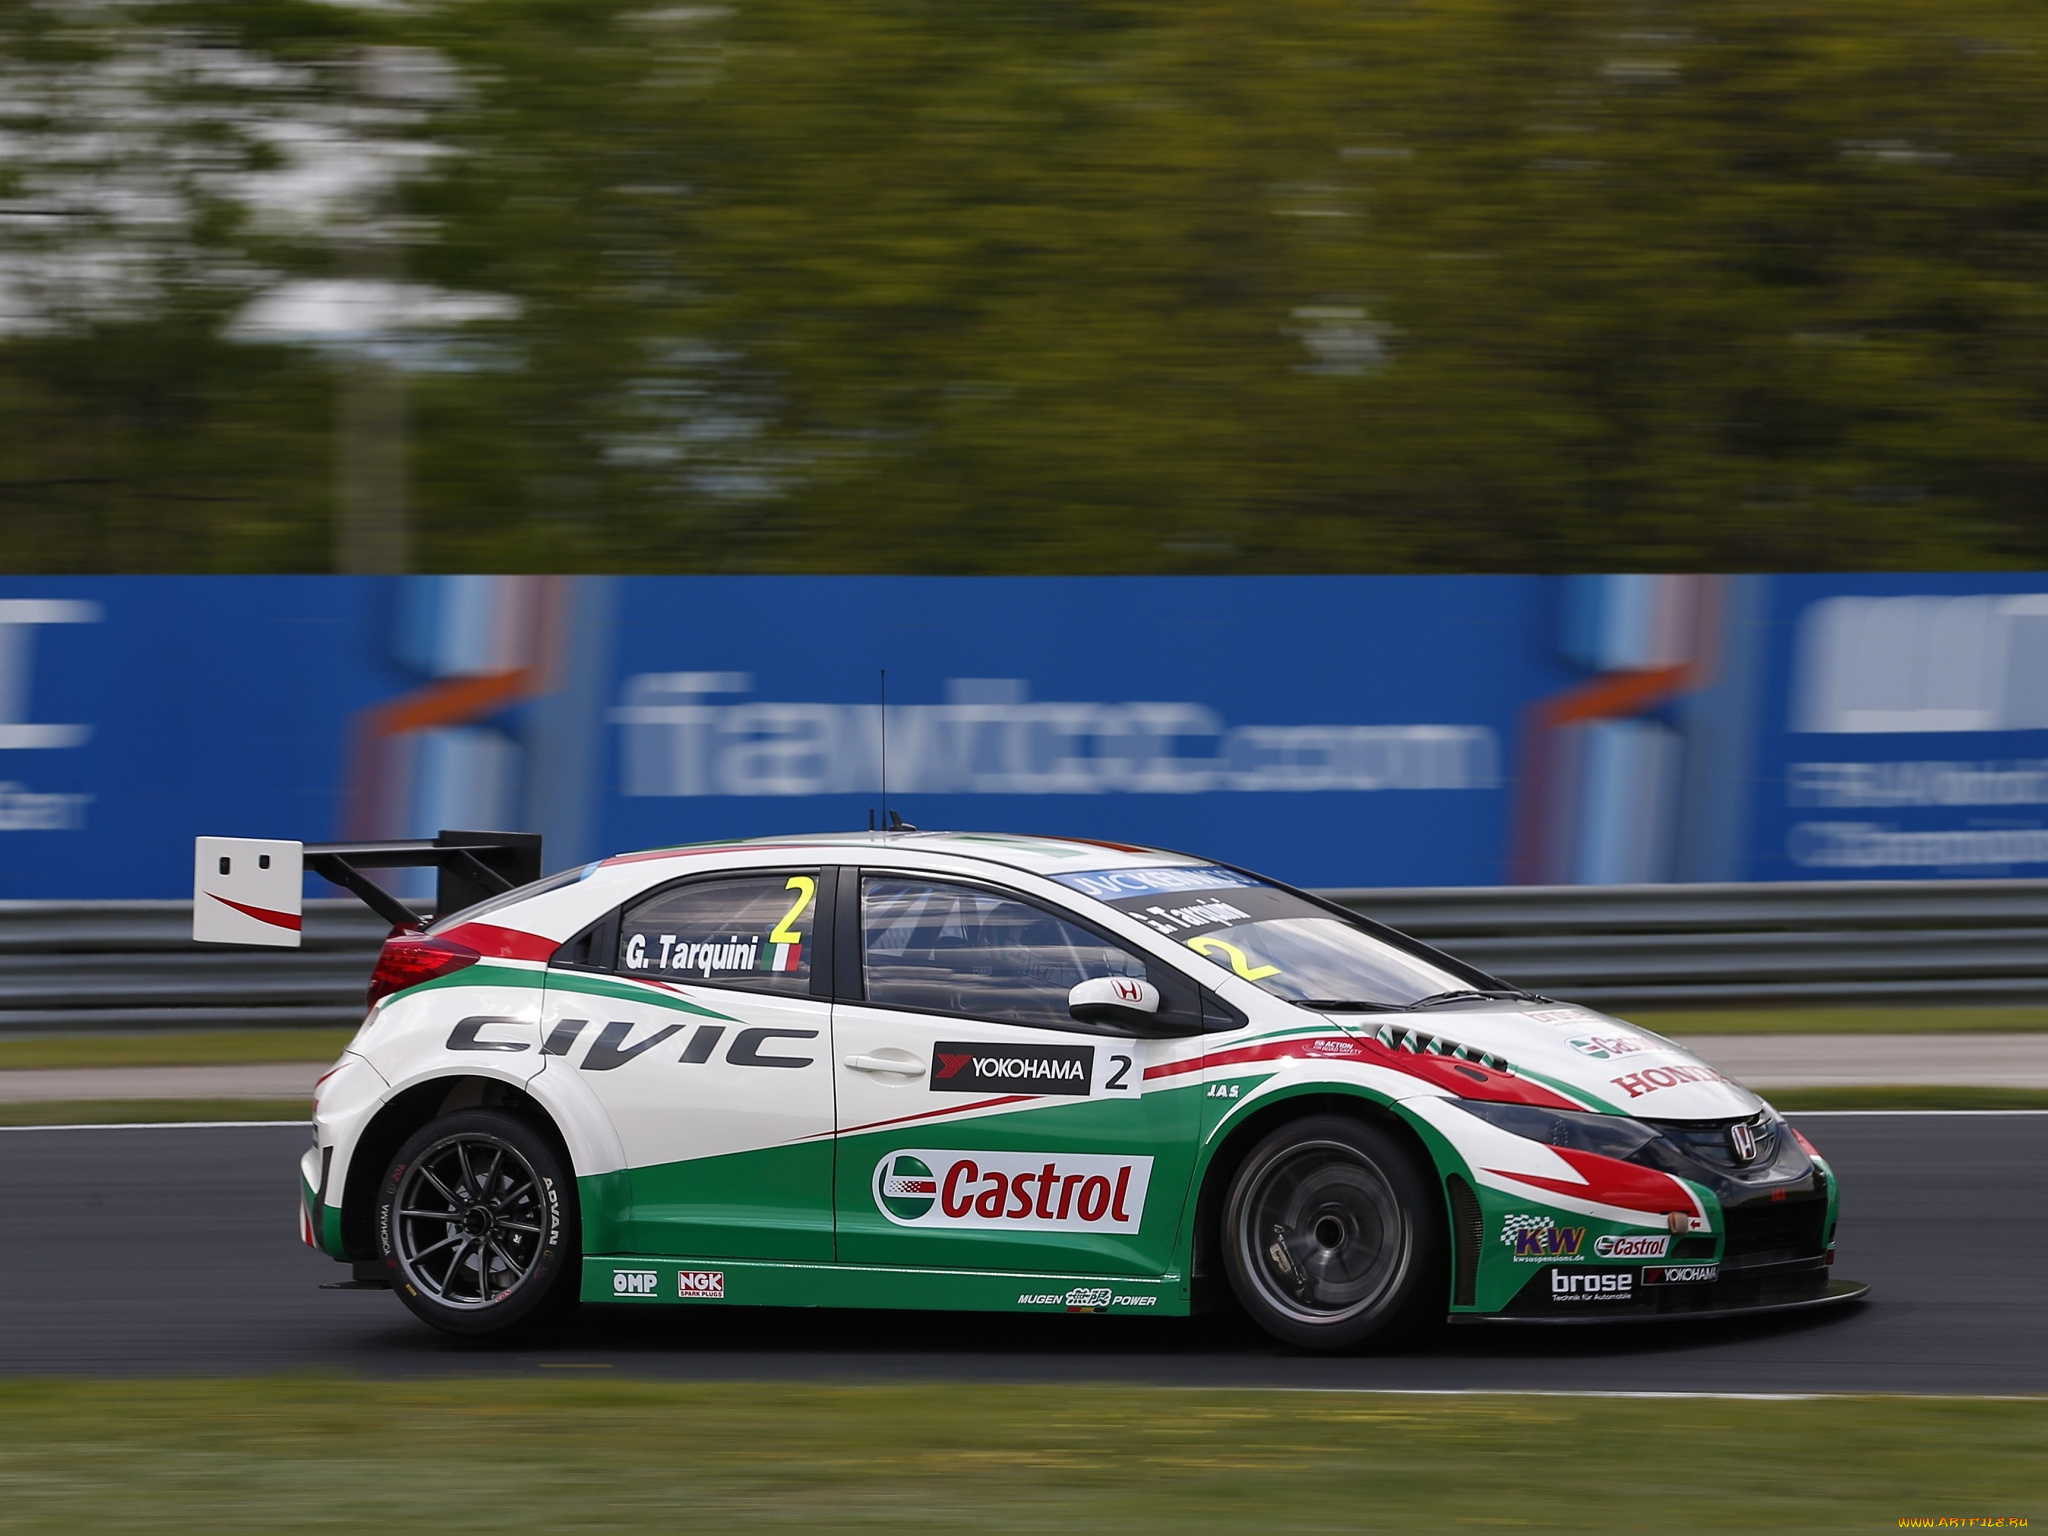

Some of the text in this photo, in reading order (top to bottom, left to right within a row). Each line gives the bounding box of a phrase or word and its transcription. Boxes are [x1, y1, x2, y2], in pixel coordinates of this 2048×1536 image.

[768, 875, 816, 943] 2
[626, 933, 759, 978] G. Tarquini
[1186, 936, 1282, 981] 2
[446, 1015, 820, 1071] CIVIC
[1325, 1041, 1354, 1049] ACTION
[972, 1057, 1084, 1081] YOKOHAMA
[1104, 1054, 1133, 1090] 2
[941, 1159, 1133, 1223] Castrol
[543, 1176, 560, 1246] ADVAN
[379, 1204, 390, 1256] YOKOHAMA
[1515, 1227, 1587, 1256] KW
[1513, 1254, 1585, 1264] kwsuspensions.de
[1613, 1238, 1667, 1256] Castrol
[613, 1273, 658, 1293] OMP
[680, 1273, 722, 1290] NGK
[1551, 1268, 1633, 1293] brose
[1664, 1266, 1717, 1282] YOKOHAMA
[1018, 1294, 1063, 1305] MUGEN
[1112, 1296, 1157, 1306] POWER
[1552, 1294, 1580, 1302] Technik
[1593, 1293, 1632, 1301] Automobile
